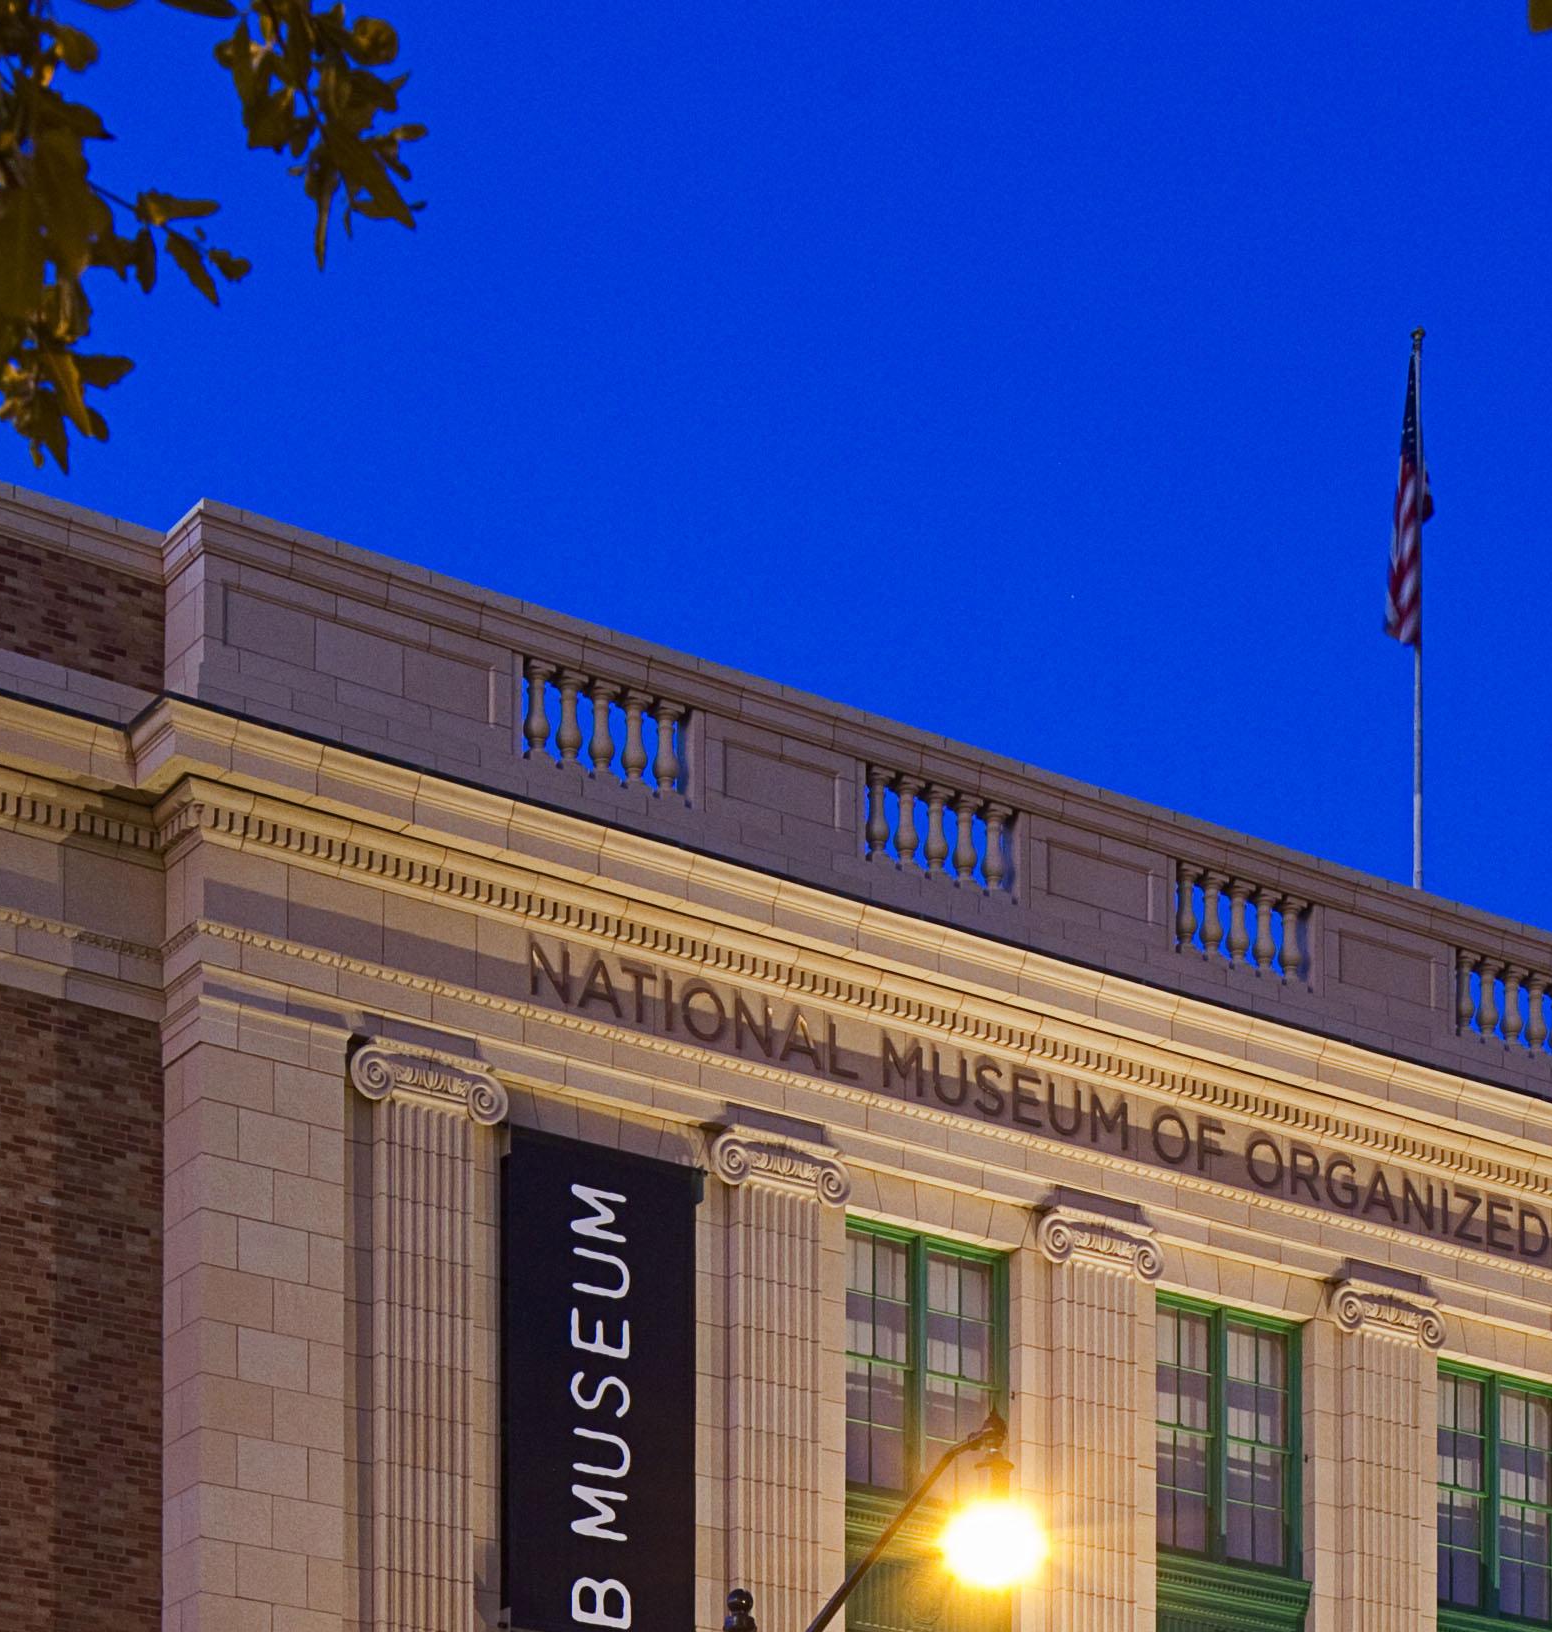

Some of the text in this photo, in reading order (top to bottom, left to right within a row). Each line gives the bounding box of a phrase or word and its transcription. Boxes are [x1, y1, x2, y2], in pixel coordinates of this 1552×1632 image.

[529, 940, 859, 1081] NATIONAL
[882, 1031, 1130, 1152] MUSEUM
[1150, 1106, 1226, 1172] OF
[1245, 1131, 1549, 1257] ORGANIZED
[570, 1183, 631, 1542] MUSEUM
